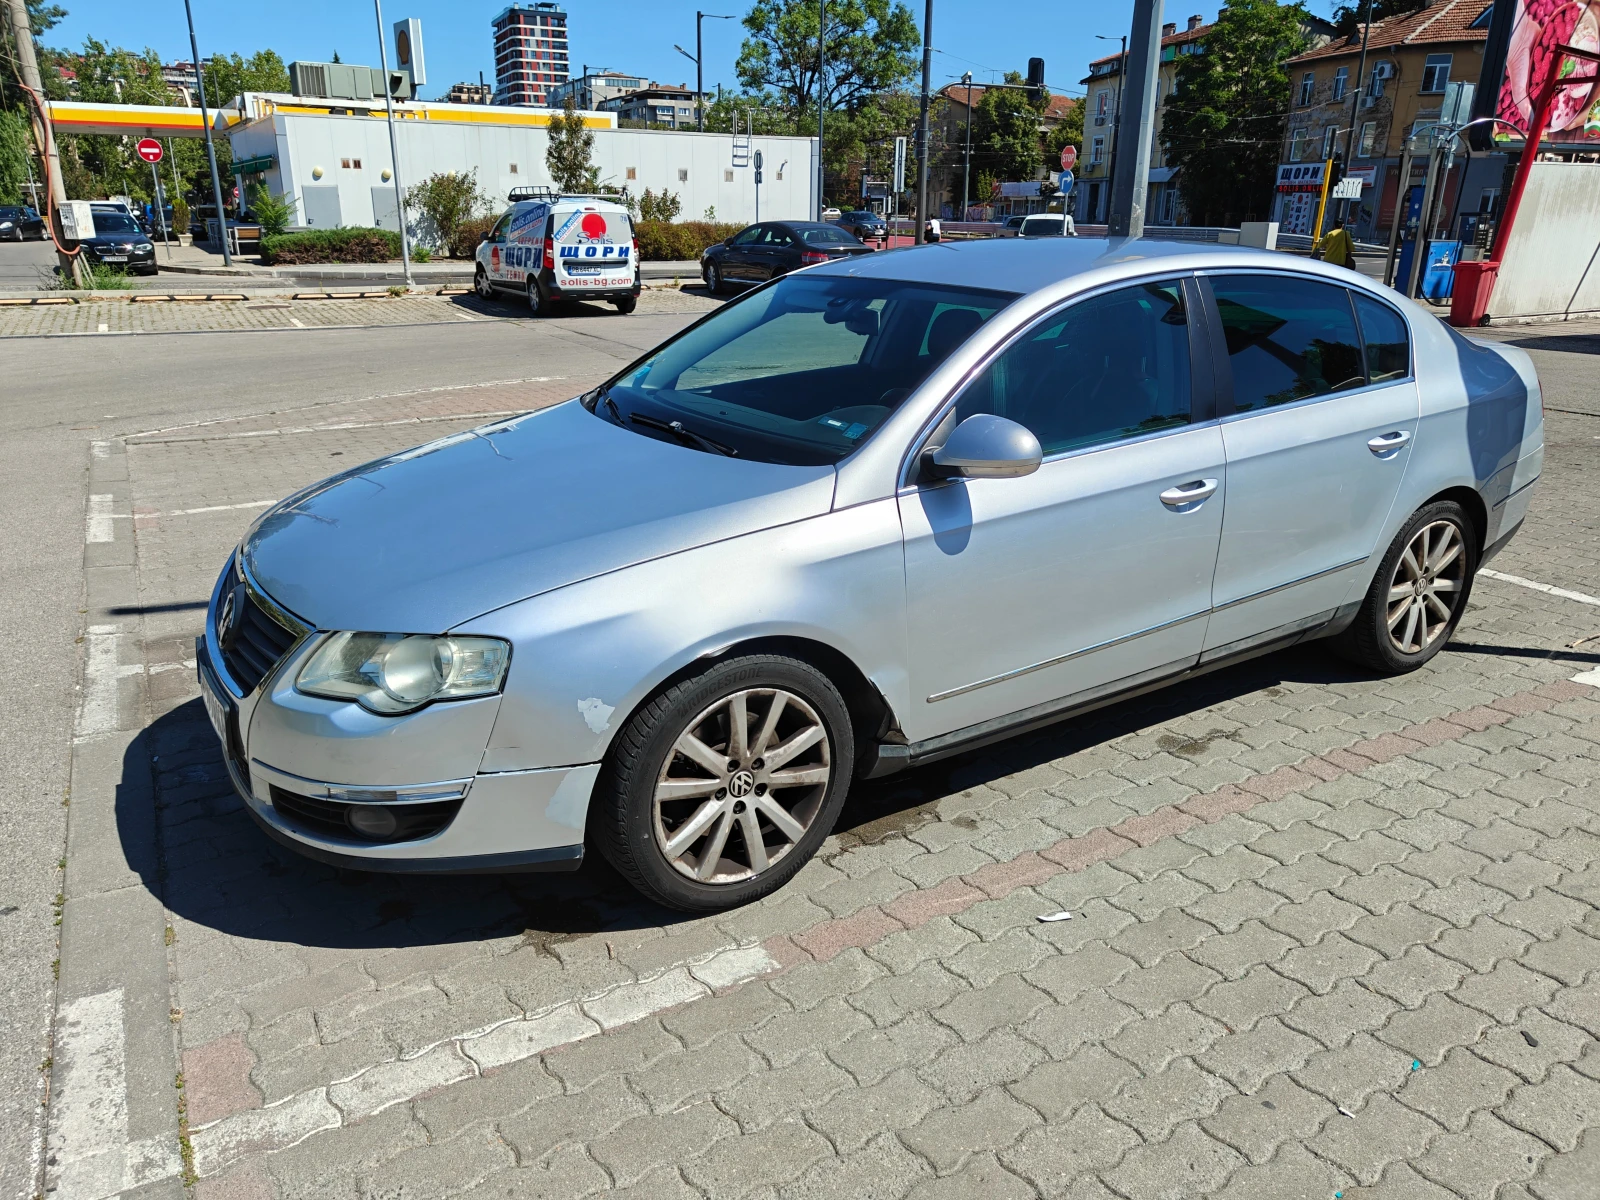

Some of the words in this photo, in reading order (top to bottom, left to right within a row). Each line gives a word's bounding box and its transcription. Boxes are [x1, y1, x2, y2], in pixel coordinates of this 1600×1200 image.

[1062, 153, 1075, 163] STOP
[1280, 166, 1321, 181] ЩОРИ
[555, 212, 582, 239] solis.online
[576, 231, 614, 245] Solis
[505, 247, 543, 269] ЩОРИ
[559, 246, 630, 258] ЩОРИ
[560, 277, 632, 287] solis-bg.com
[676, 666, 764, 719] BRIDGESTONE
